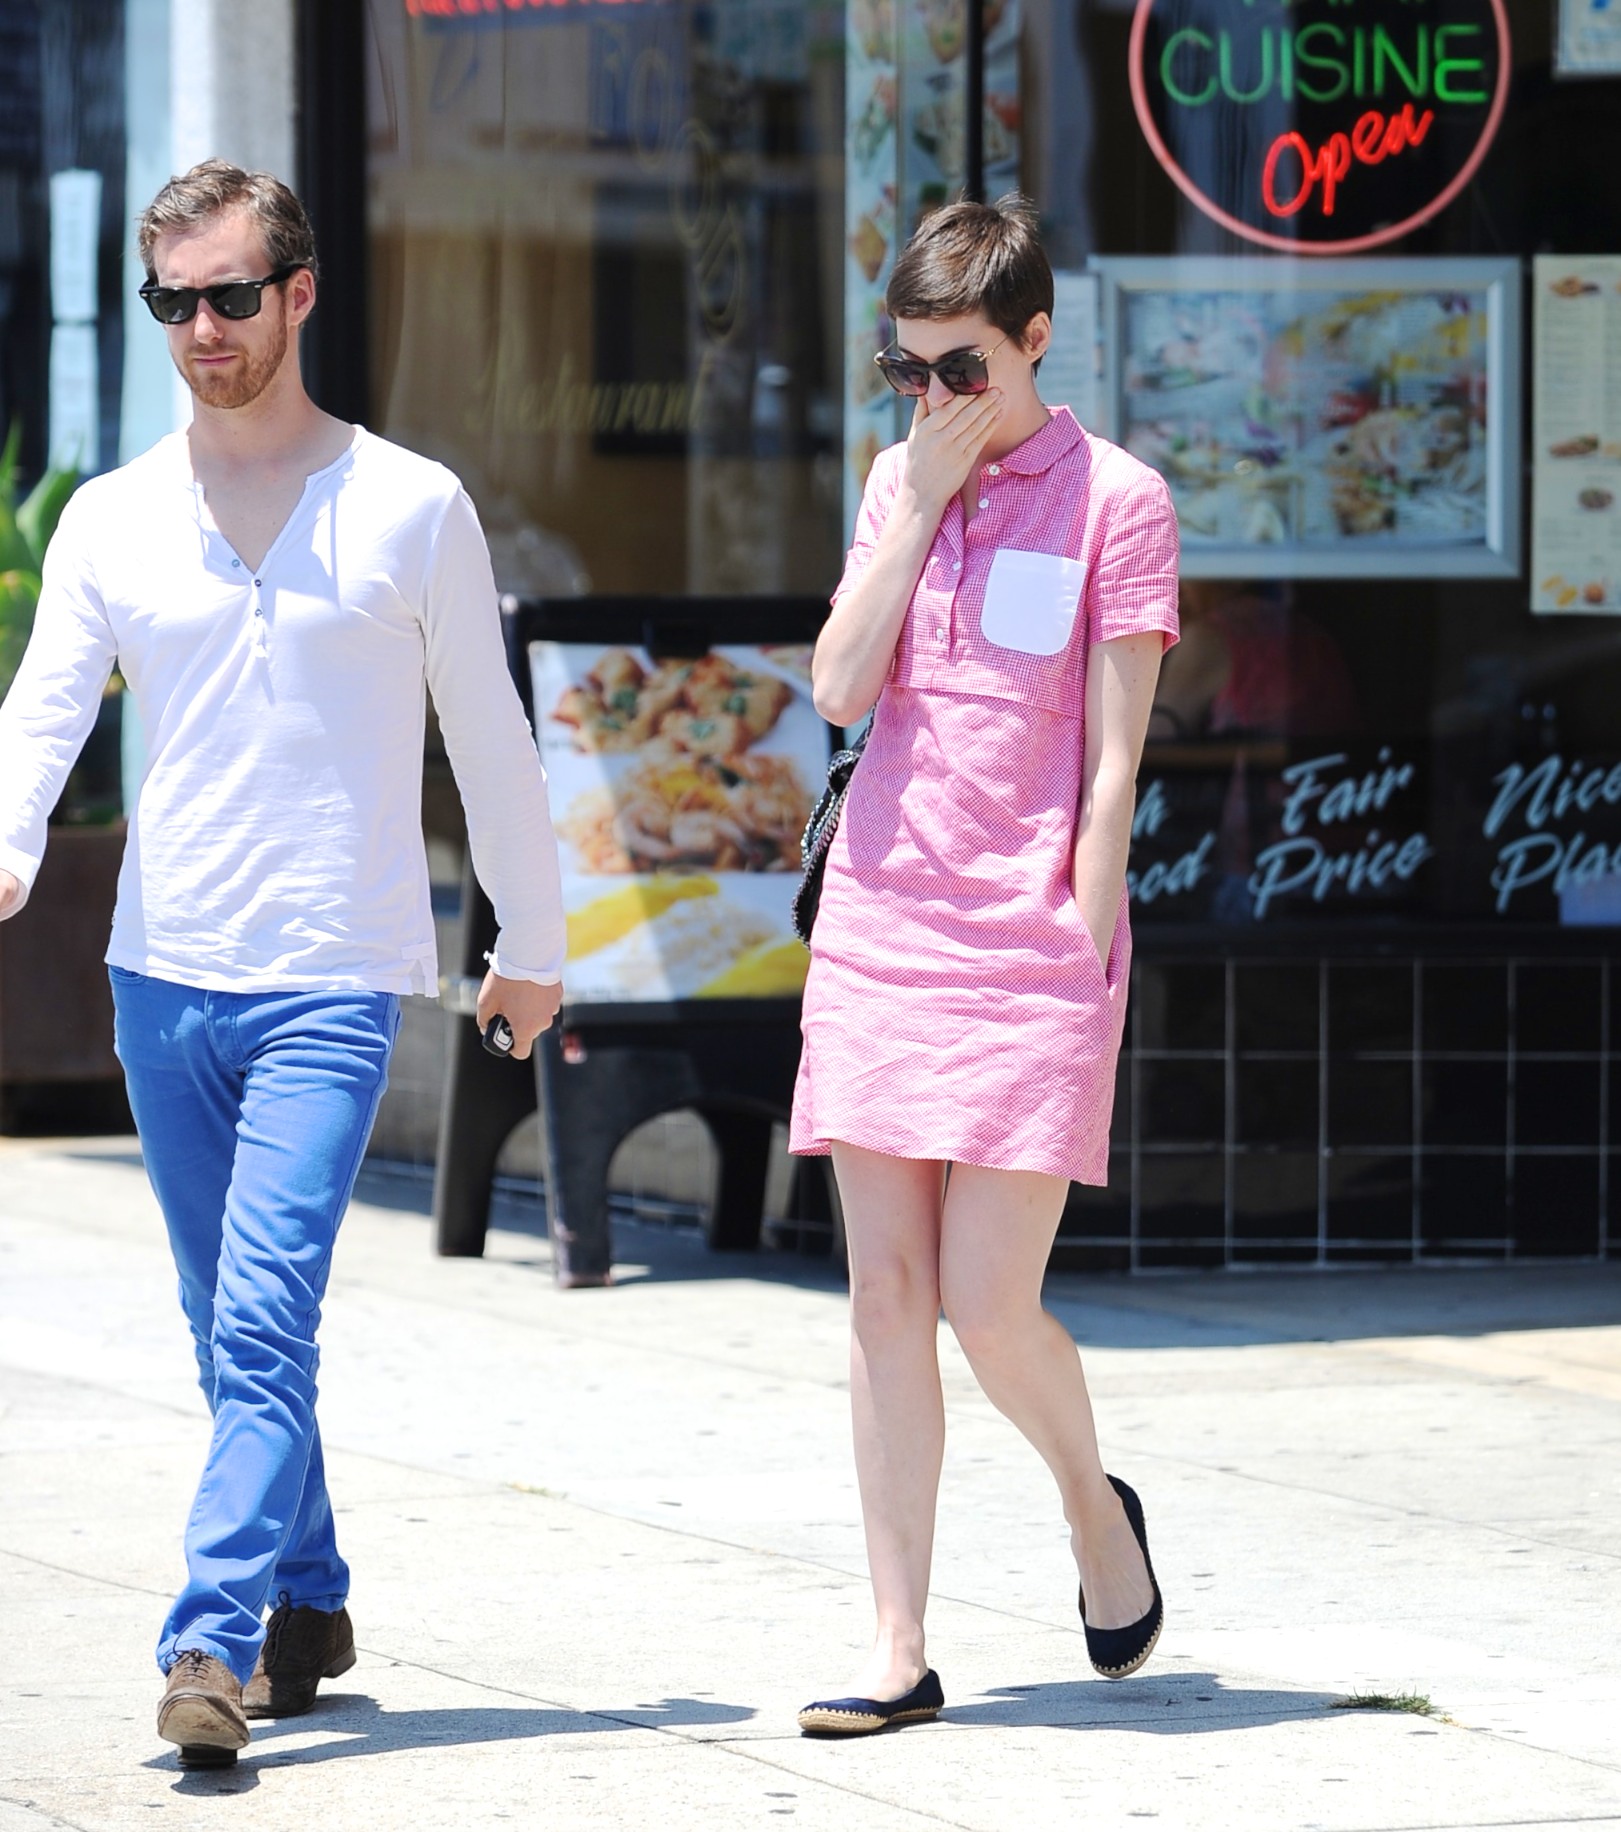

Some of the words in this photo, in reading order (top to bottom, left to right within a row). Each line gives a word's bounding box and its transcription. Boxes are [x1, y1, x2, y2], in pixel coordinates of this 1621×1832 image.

[1160, 23, 1488, 106] CUISINE
[1261, 102, 1435, 218] Open
[1281, 746, 1414, 835] Fair
[1248, 829, 1431, 920] Price
